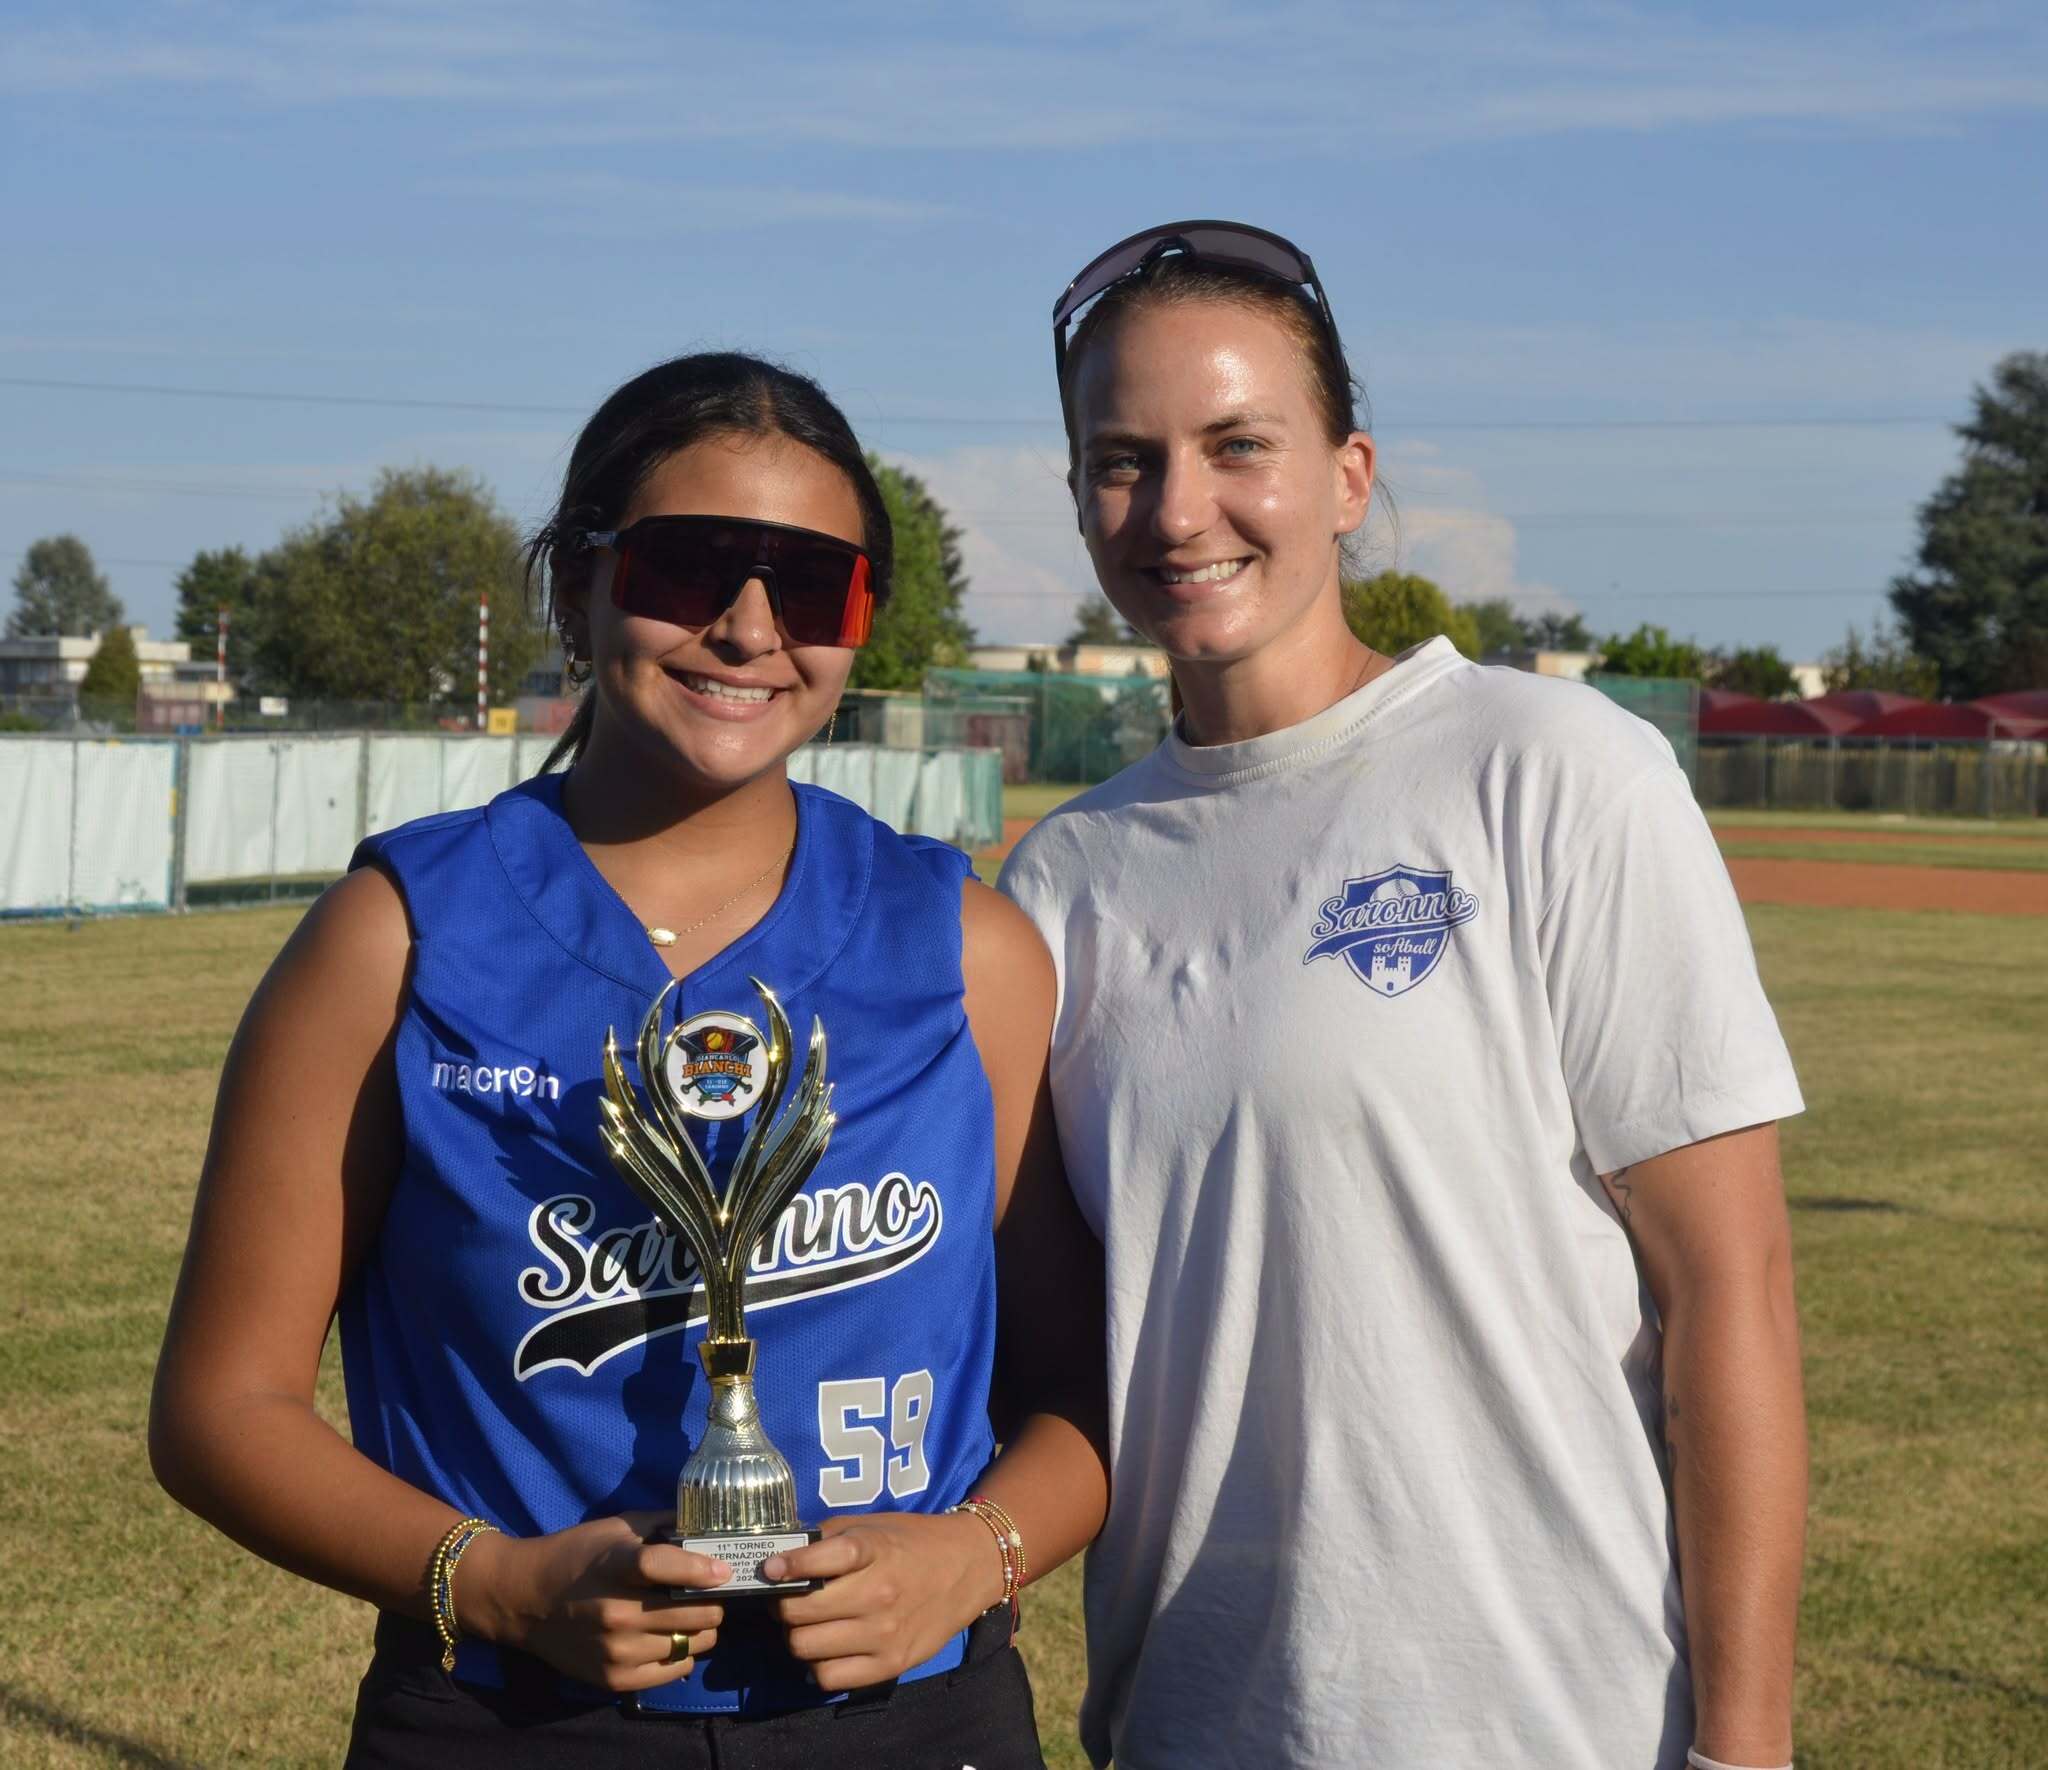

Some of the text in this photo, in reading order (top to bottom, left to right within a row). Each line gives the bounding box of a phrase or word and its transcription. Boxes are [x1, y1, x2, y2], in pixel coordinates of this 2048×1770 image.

[1311, 887, 1479, 938] Saronno
[1373, 937, 1437, 957] softball
[432, 1063, 559, 1100] macron
[682, 1060, 752, 1078] BIANCHI
[518, 1171, 943, 1309] Sarnno
[818, 1368, 933, 1507] 59
[734, 1541, 775, 1550] TORNEO
